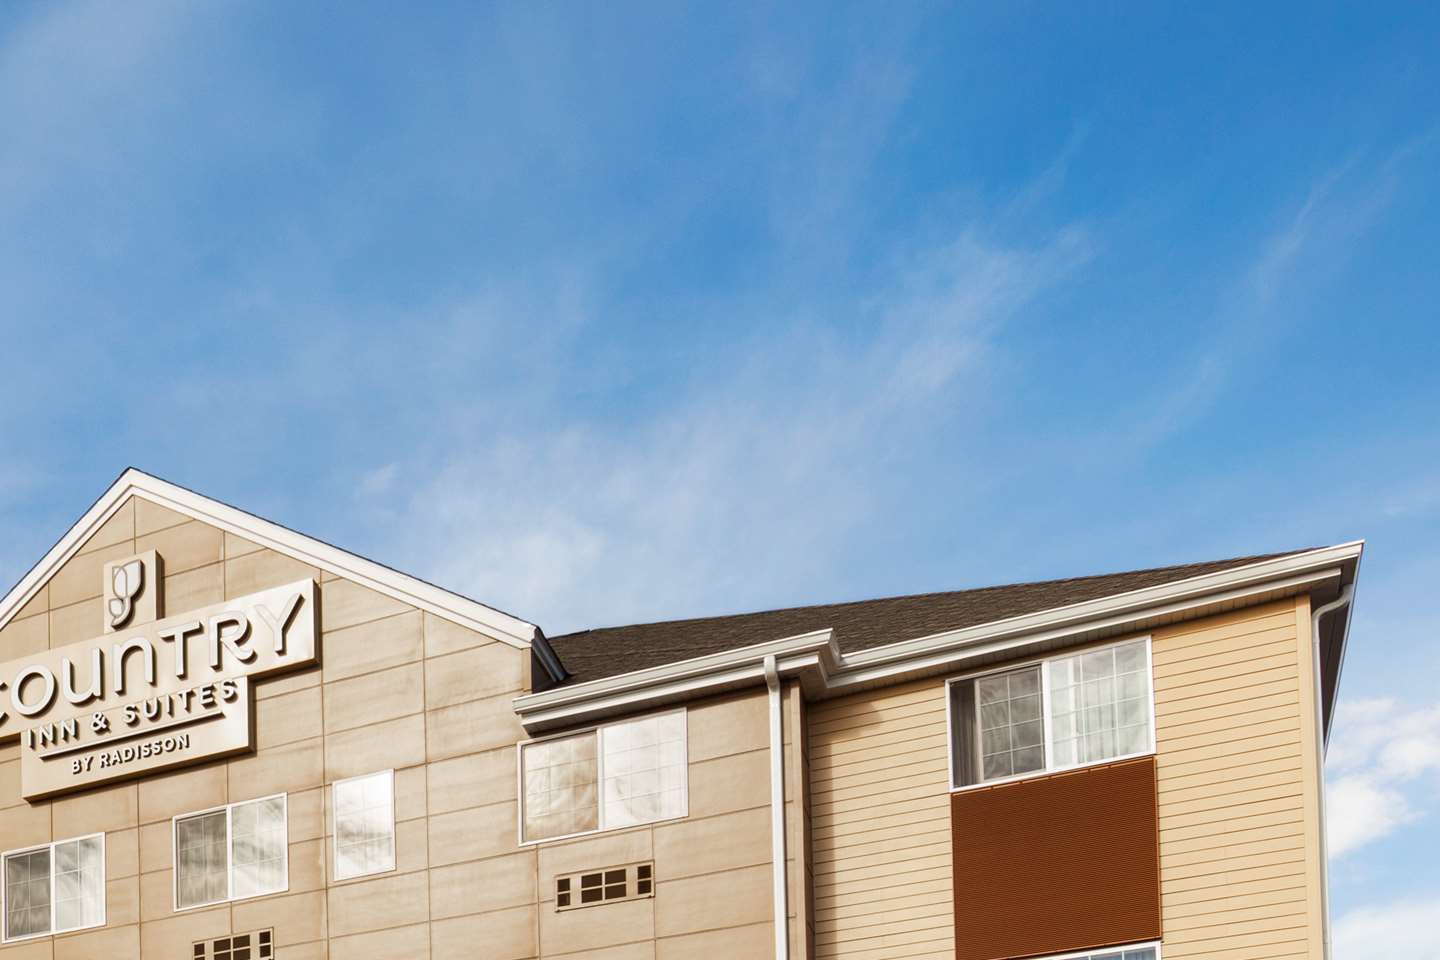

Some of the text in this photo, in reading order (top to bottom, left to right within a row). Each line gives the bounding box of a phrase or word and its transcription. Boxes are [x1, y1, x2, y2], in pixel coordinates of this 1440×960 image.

[27, 679, 238, 749] INN & SUITES
[72, 734, 191, 774] BY RADISSON
